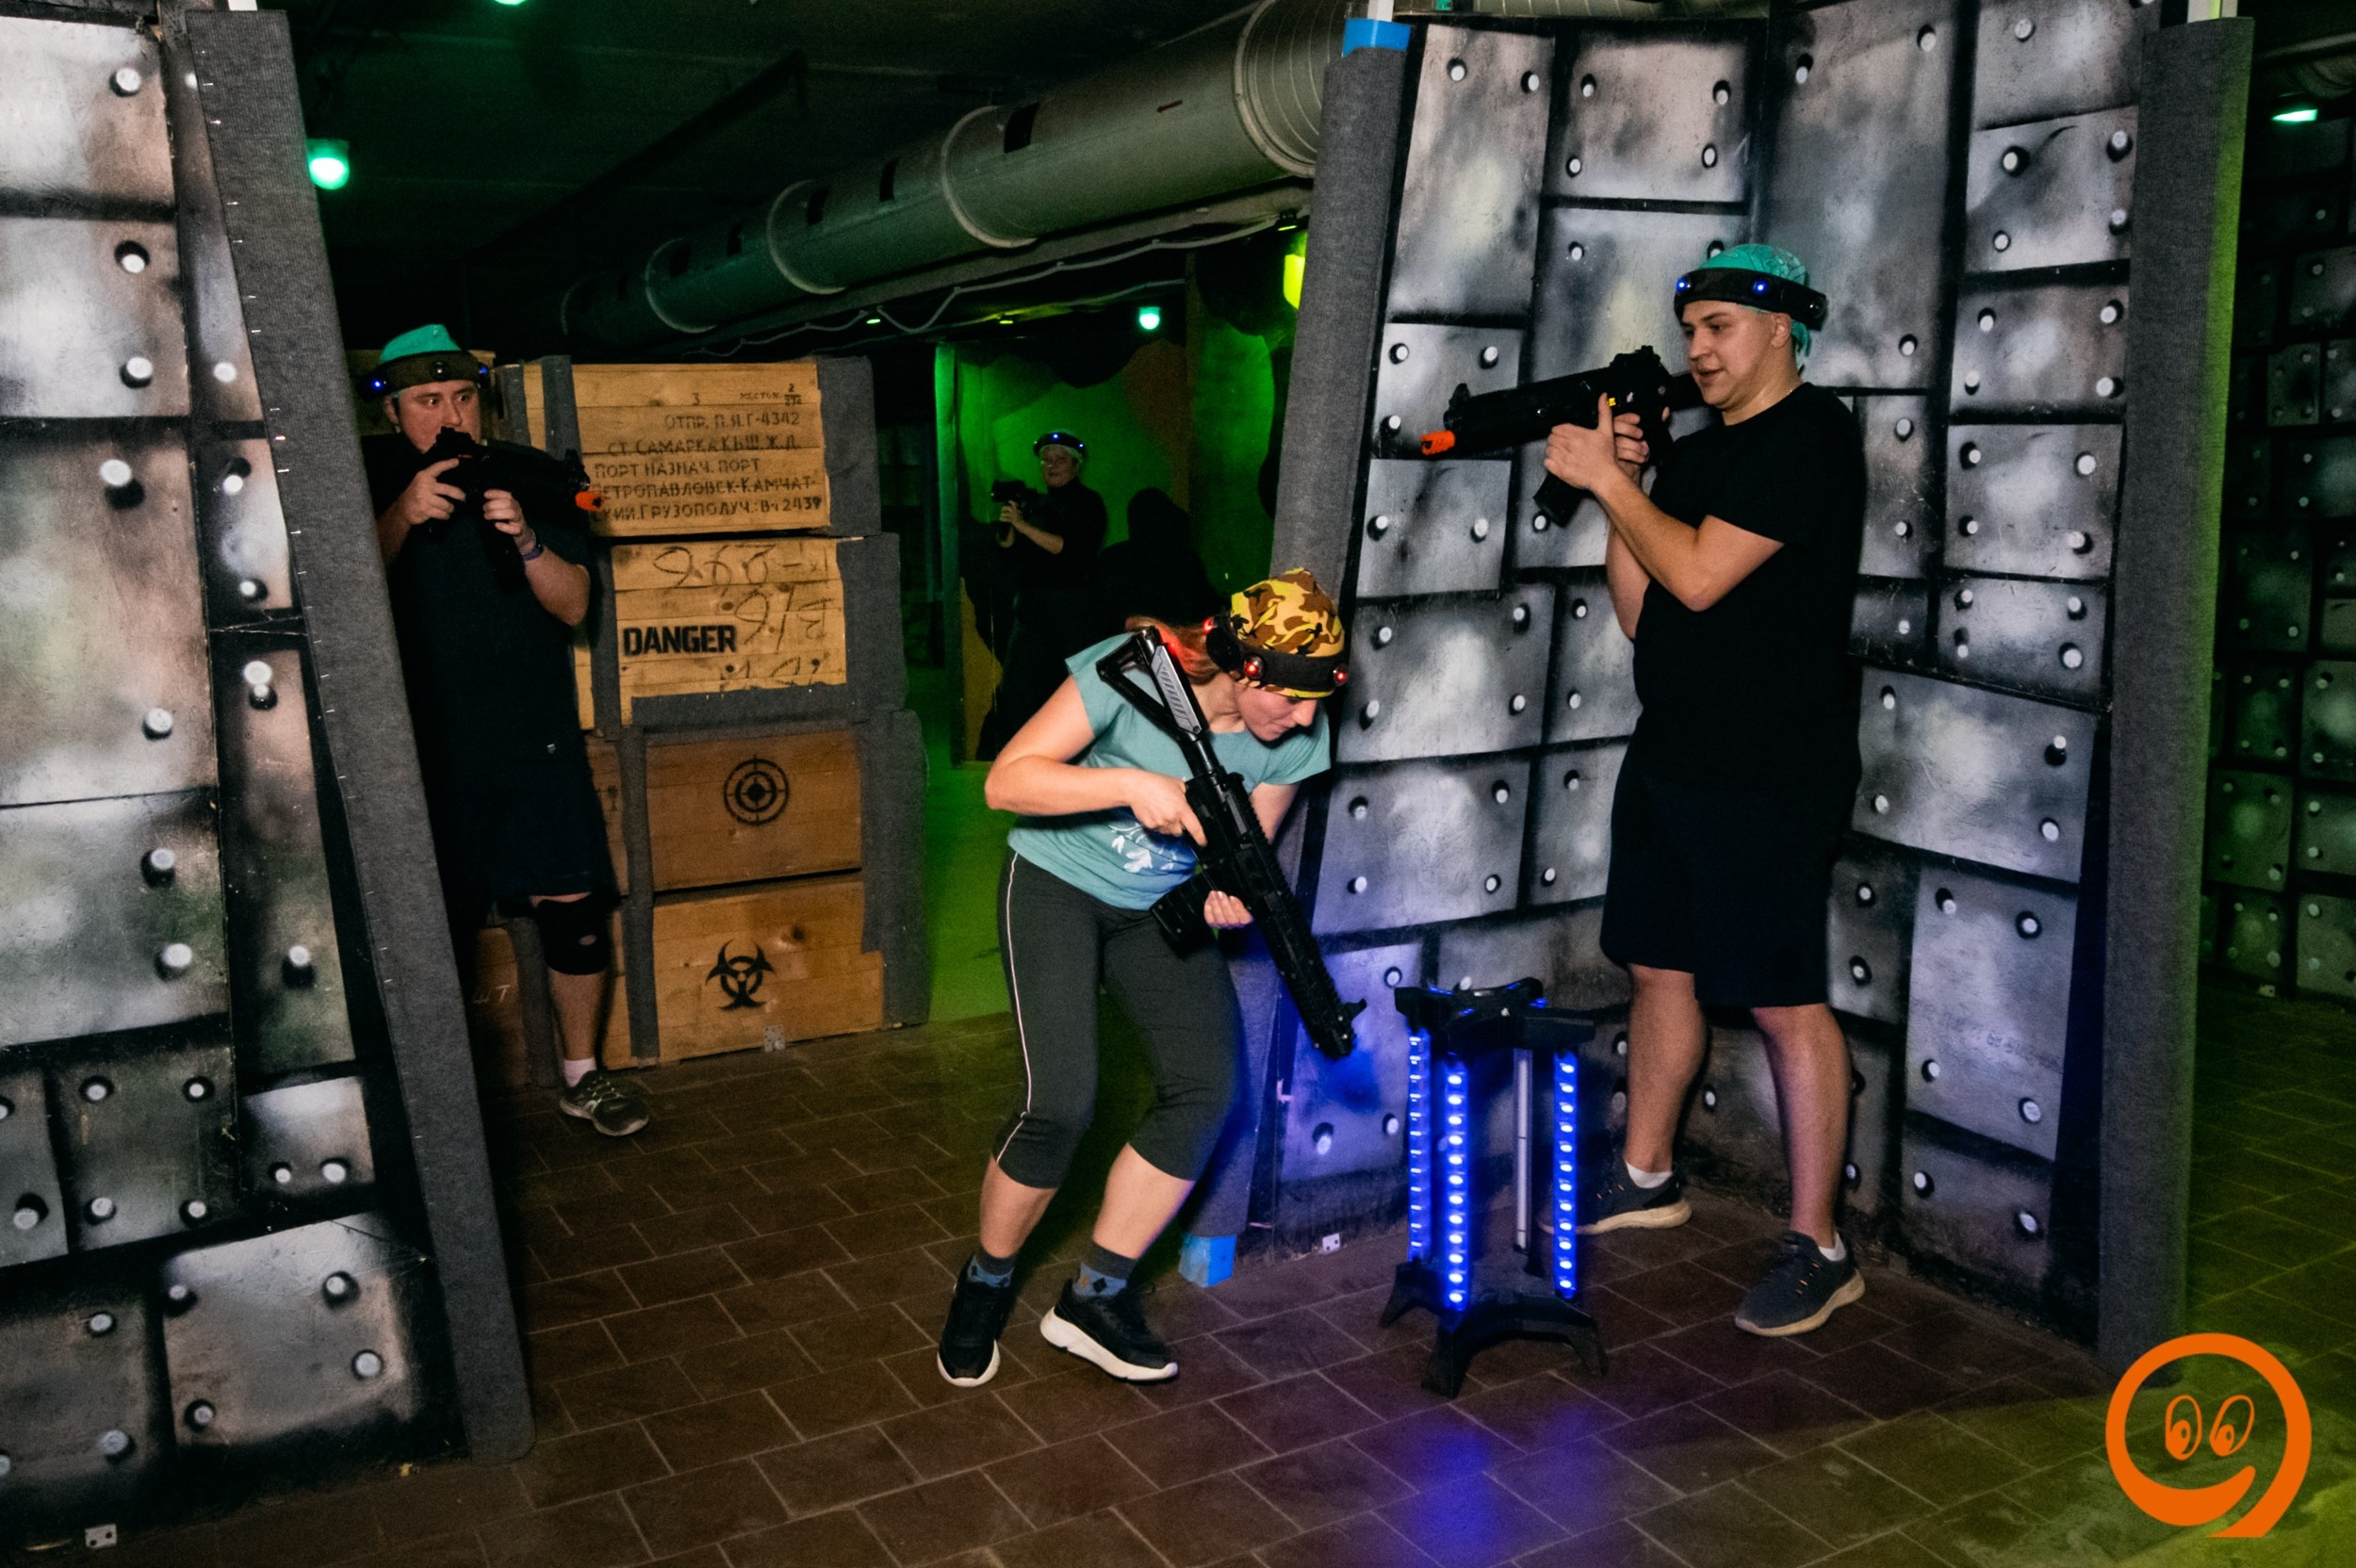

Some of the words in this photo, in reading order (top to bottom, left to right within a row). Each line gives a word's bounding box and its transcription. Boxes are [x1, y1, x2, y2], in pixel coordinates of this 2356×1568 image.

[594, 462, 640, 479] ПОРТ
[718, 457, 760, 473] ПОРТ
[622, 624, 737, 657] DANGER
